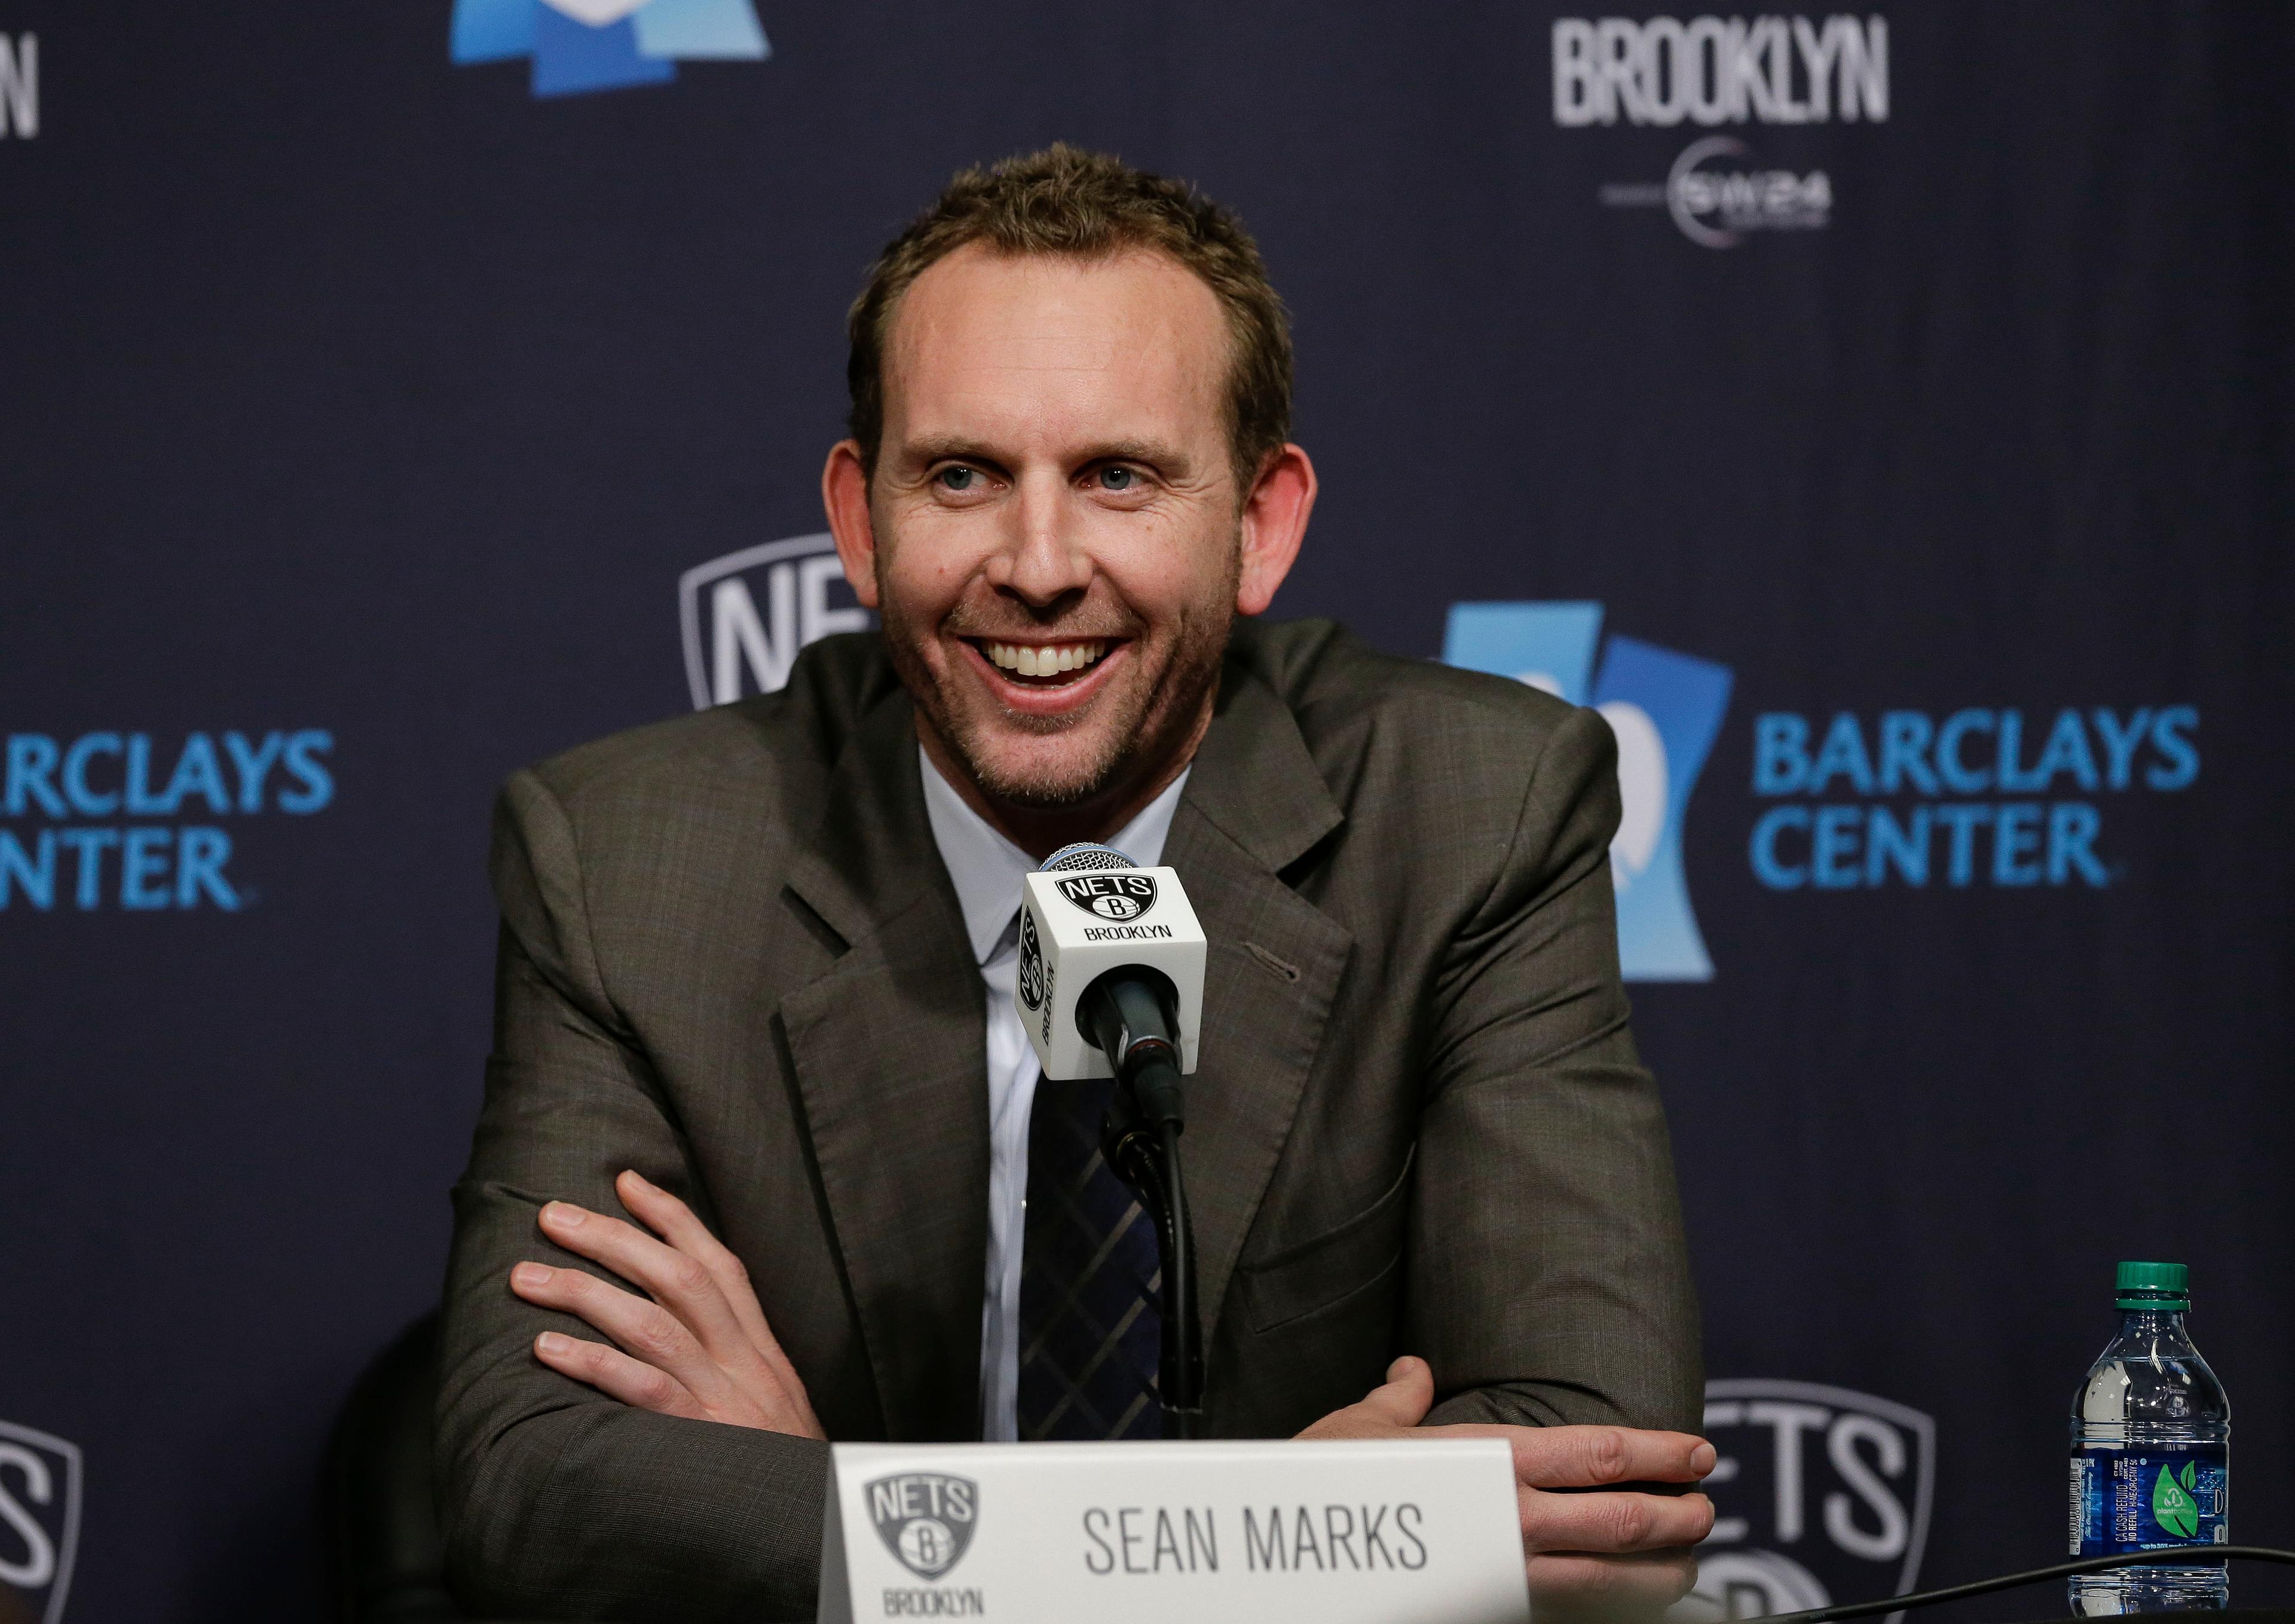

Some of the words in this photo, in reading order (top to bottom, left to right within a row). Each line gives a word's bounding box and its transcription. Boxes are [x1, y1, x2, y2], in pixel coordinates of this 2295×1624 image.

[1553, 14, 1889, 126] BROOKLYN
[1752, 705, 2201, 796] BARCLAYS
[0, 728, 336, 819] RCLAYS
[1749, 802, 2110, 890] CENTER
[1064, 877, 1152, 900] NETS
[1106, 898, 1127, 916] B
[1084, 925, 1173, 941] BROOKLYN
[1021, 917, 1036, 1003] NETS
[1042, 960, 1055, 1047] BROOKLYN
[2085, 1472, 2094, 1499] Company
[2116, 1485, 2128, 1512] REFUND
[873, 1478, 972, 1524] NETS
[2116, 1513, 2128, 1531] CASH
[1083, 1506, 1219, 1575] SEAN
[1243, 1503, 1428, 1573] MARKS
[2116, 1533, 2128, 1542] CA
[2129, 1532, 2137, 1542] NO
[882, 1588, 984, 1617] BROOKLYN
